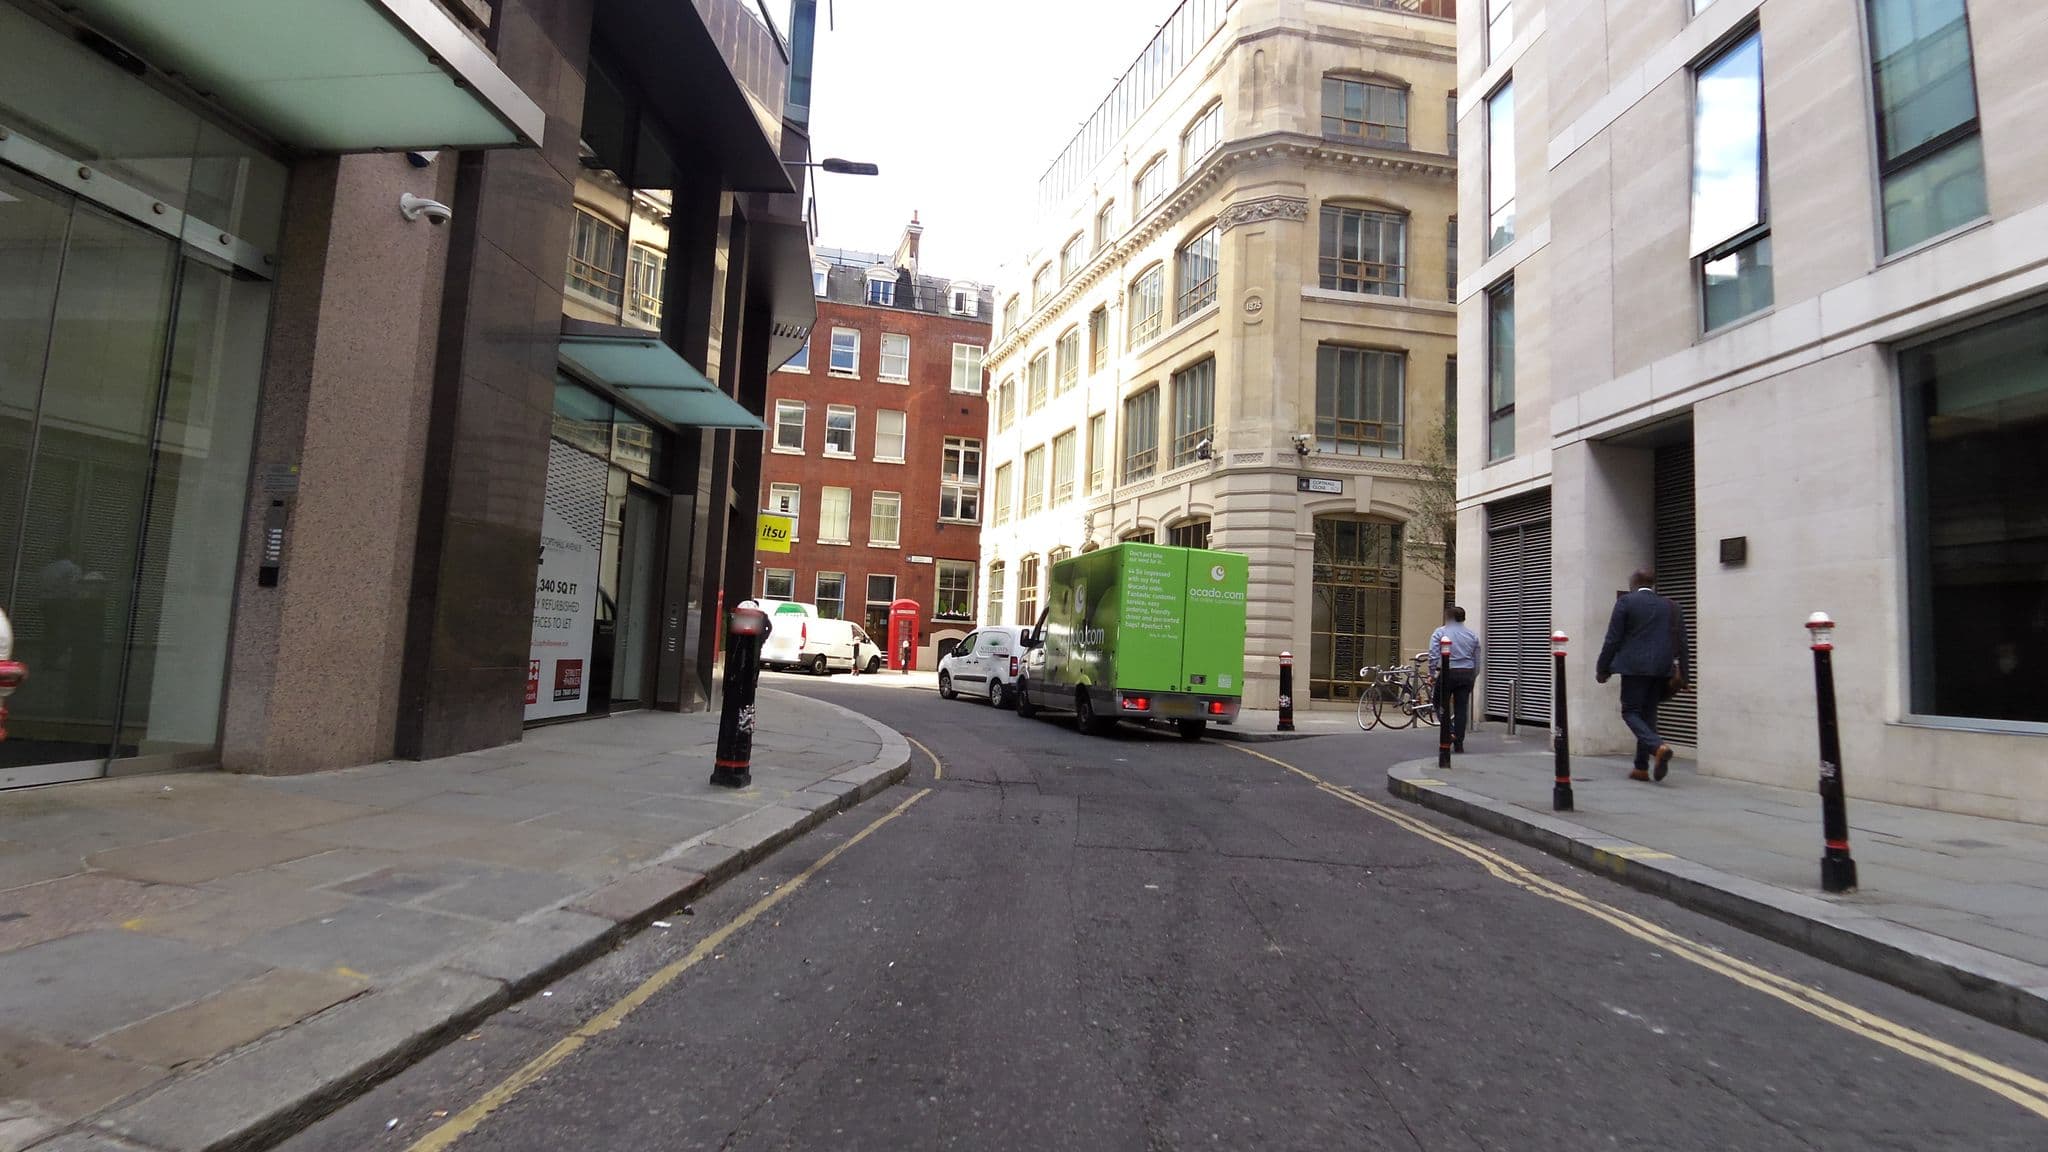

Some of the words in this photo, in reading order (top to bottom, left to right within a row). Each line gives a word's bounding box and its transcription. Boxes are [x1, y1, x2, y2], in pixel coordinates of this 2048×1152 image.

[762, 525, 787, 538] itsu
[557, 581, 568, 594] SQ
[569, 583, 577, 595] FT
[1189, 588, 1244, 601] ocado.com
[541, 598, 580, 613] REFURBISHED
[552, 617, 562, 629] TO
